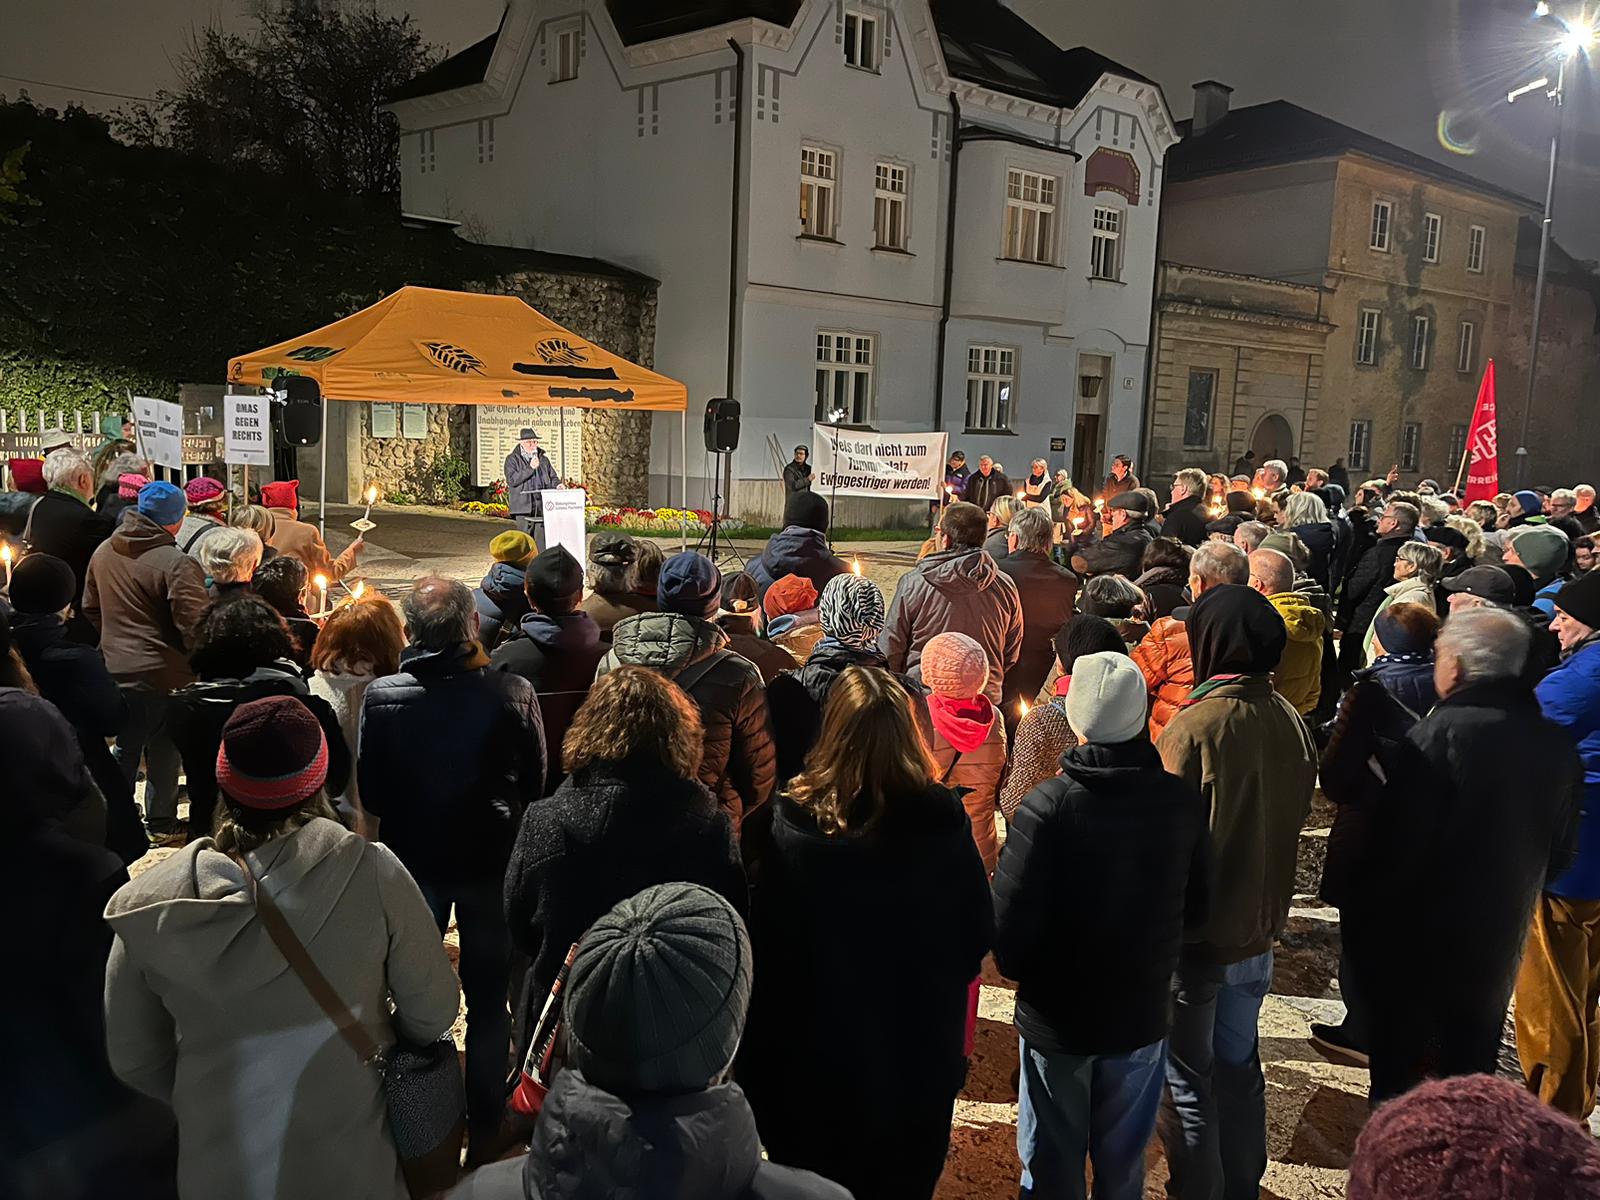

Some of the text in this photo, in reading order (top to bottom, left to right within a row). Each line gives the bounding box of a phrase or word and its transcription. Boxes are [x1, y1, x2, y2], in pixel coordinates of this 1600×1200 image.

[235, 402, 258, 414] OMAS
[234, 416, 259, 428] GEGEN
[231, 430, 263, 442] RECHTS
[854, 441, 873, 456] darf
[875, 443, 903, 457] nicht
[905, 445, 927, 456] zum
[820, 472, 931, 490] Ewiggestriger werden!
